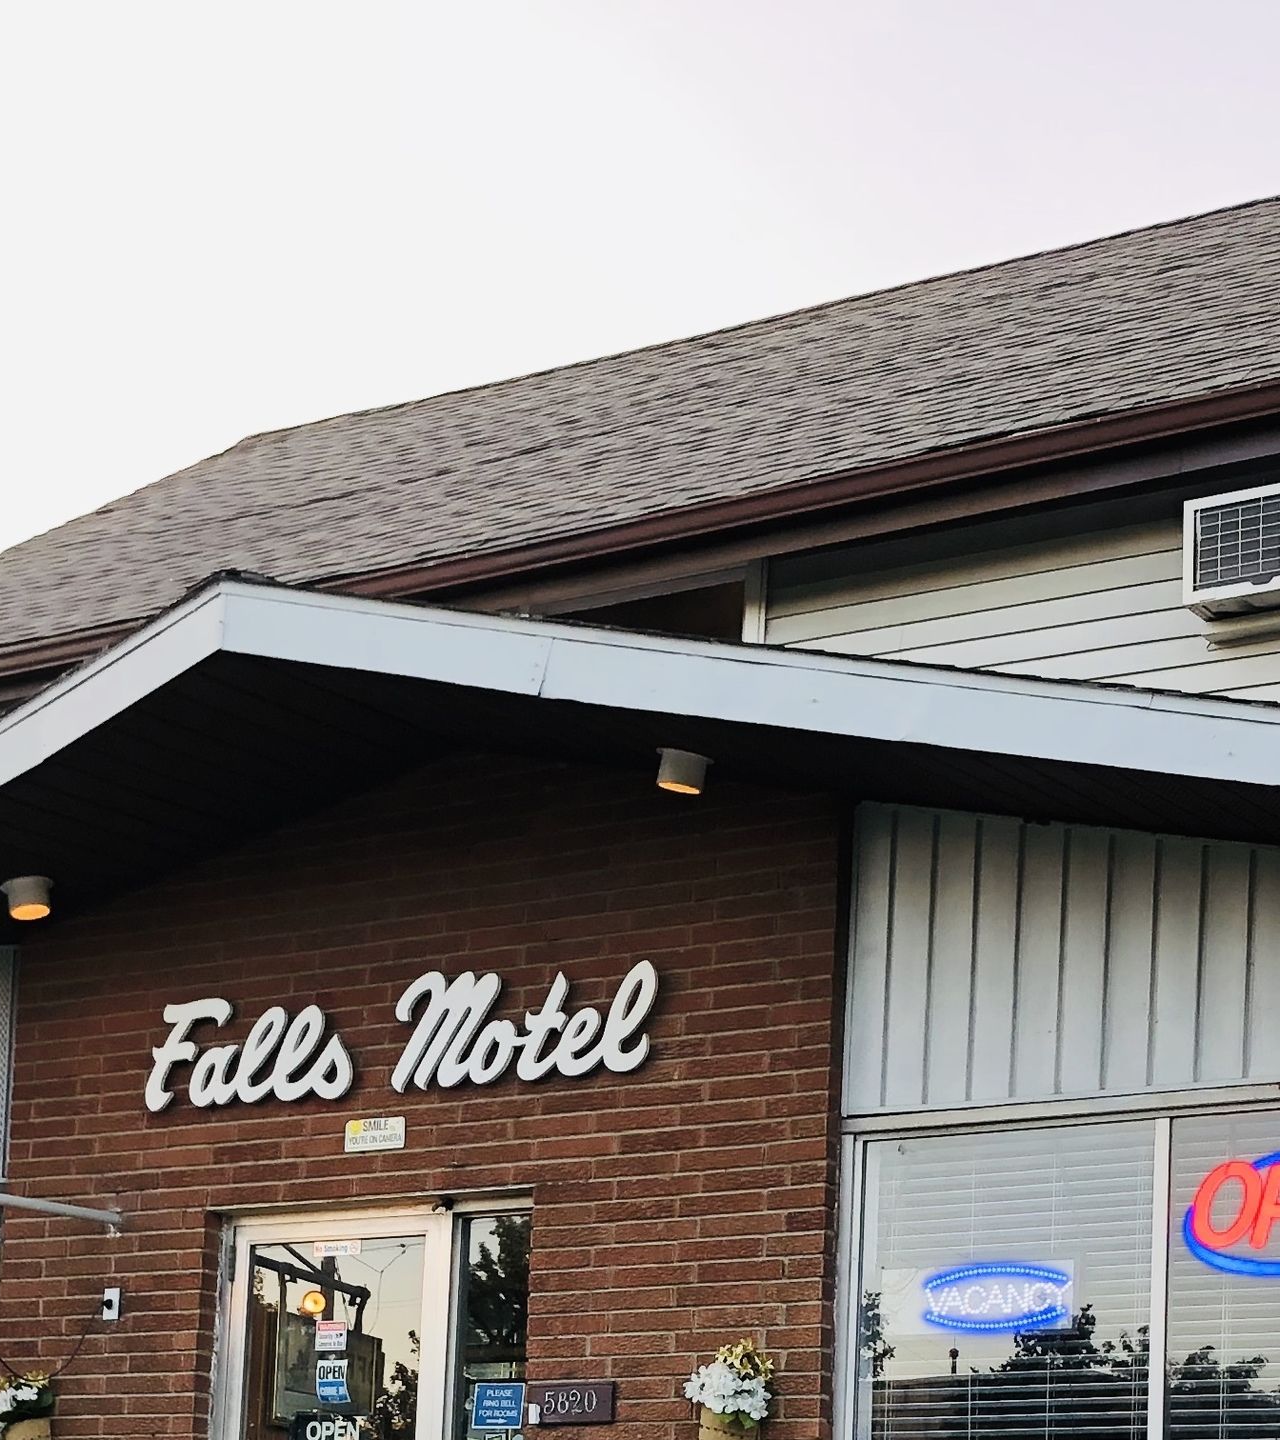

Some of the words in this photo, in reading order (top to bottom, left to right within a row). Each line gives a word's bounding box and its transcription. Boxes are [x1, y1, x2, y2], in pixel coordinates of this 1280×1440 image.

[145, 998, 353, 1112] Falls
[390, 960, 659, 1094] Motel
[363, 1119, 389, 1131] SMILE
[369, 1135, 378, 1144] ON
[379, 1133, 402, 1143] CAMERA
[924, 1280, 1073, 1316] VACANCY
[318, 1365, 346, 1380] OPEN
[486, 1389, 513, 1397] PLEASE
[482, 1399, 499, 1407] RING
[500, 1399, 516, 1407] BELL
[543, 1389, 597, 1415] 5820
[478, 1409, 492, 1417] FOR
[493, 1409, 518, 1417] ROOMS
